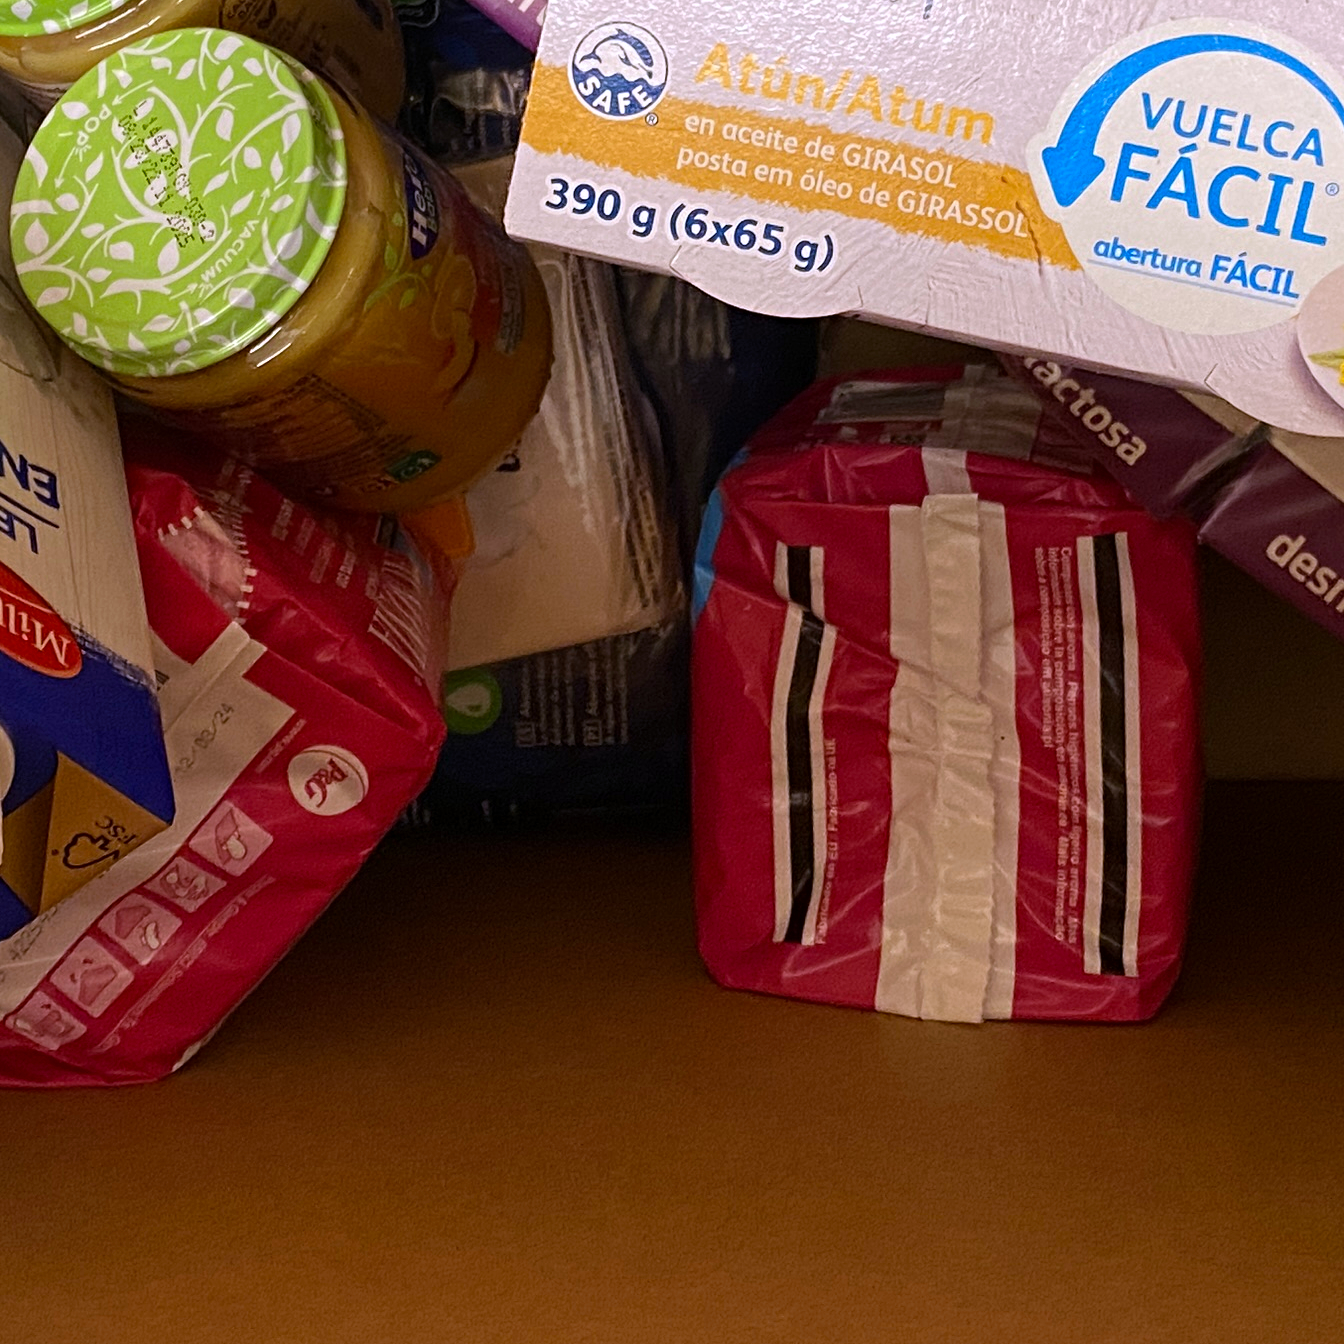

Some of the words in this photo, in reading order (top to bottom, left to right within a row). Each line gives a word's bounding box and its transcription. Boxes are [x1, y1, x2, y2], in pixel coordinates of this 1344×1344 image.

[76, 103, 112, 146] POP
[577, 76, 652, 117] SAFE
[694, 41, 996, 147] Atún/Atum
[1141, 91, 1326, 168] VUELCA
[684, 114, 715, 137] en
[722, 120, 798, 156] aceite
[804, 135, 834, 163] de
[841, 143, 958, 190] GIRASOL
[545, 177, 623, 224] 390
[633, 201, 657, 238] g
[668, 201, 785, 257] (6x65
[793, 233, 835, 274] g)
[676, 146, 749, 183] posta
[753, 162, 792, 186] em
[799, 167, 853, 204] óleo
[858, 179, 890, 210] de
[896, 188, 1029, 240] GIRASSOL
[1109, 141, 1328, 247] FÁCIL
[199, 217, 260, 284] VACUUM
[1093, 237, 1203, 279] abertura
[1207, 250, 1301, 301] FÁCIL
[299, 754, 349, 808] P&G
